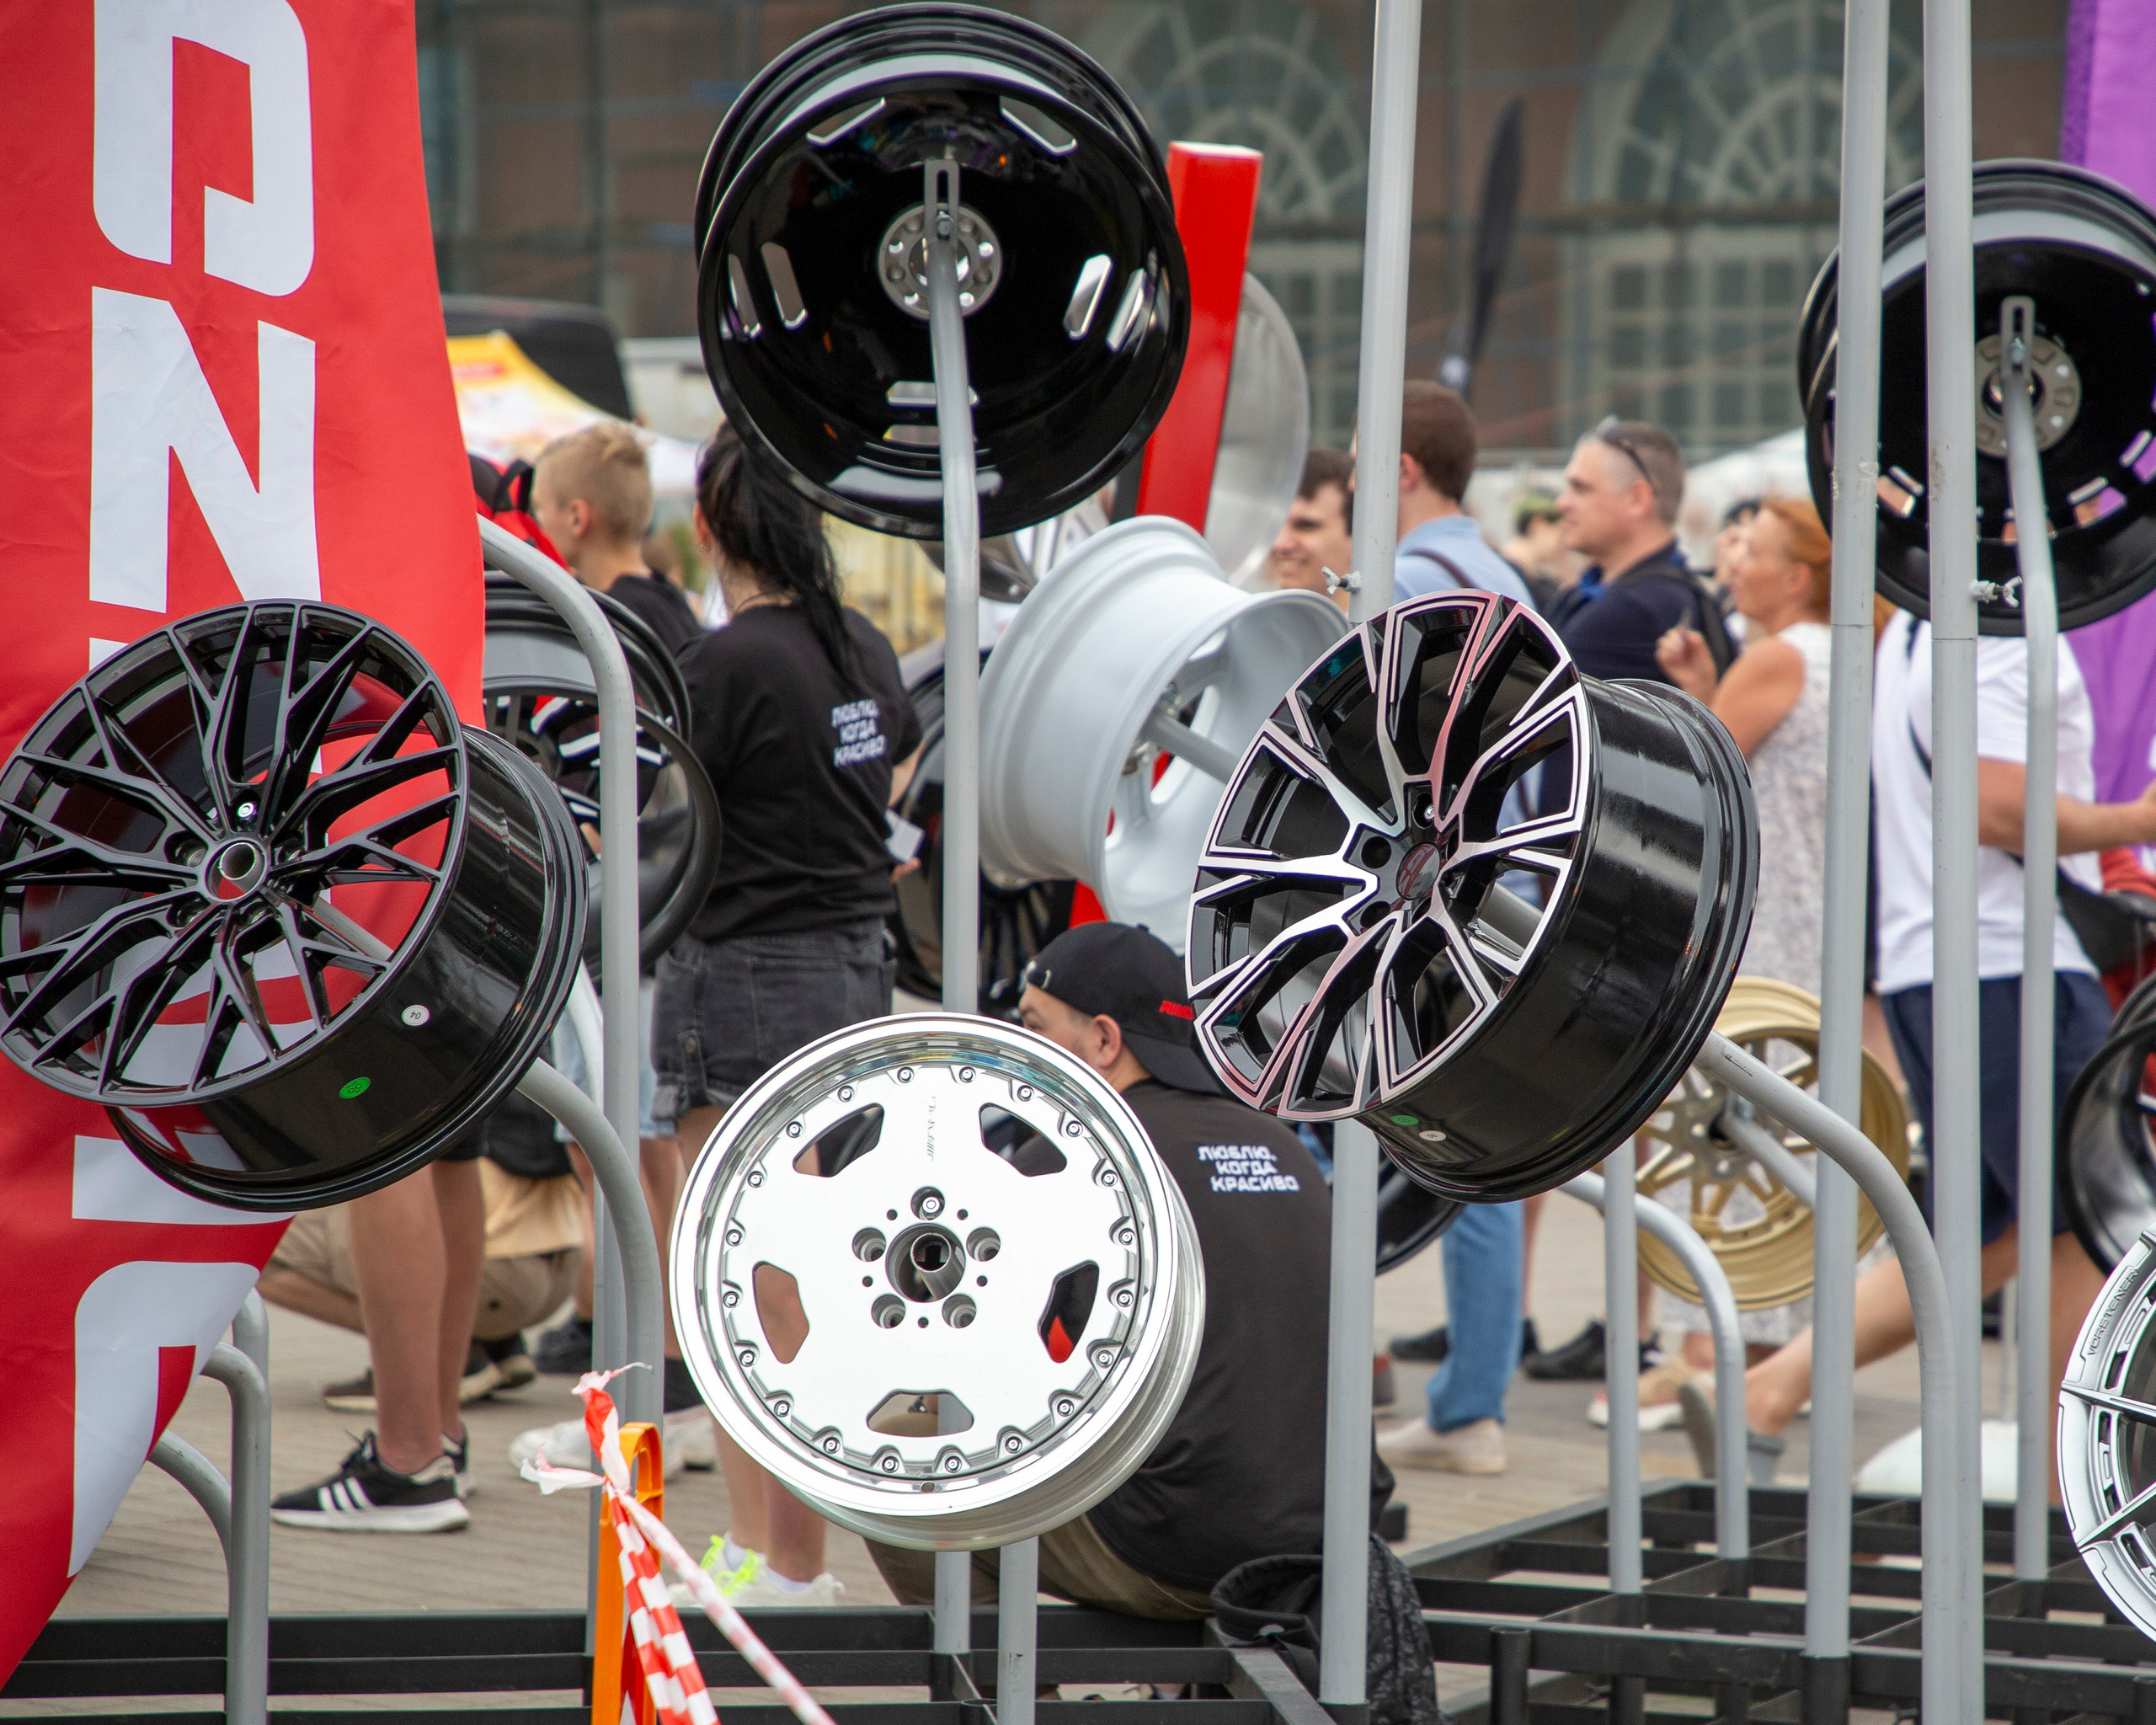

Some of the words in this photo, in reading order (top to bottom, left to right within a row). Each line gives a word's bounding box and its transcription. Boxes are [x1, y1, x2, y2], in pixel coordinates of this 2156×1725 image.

[839, 718, 877, 745] КОГДА
[833, 734, 886, 767] КРАСИВО
[1198, 1145, 1278, 1162] ЛЮБЛЮ,
[1215, 1160, 1278, 1176] КОГДА
[1210, 1174, 1300, 1193] КРАСИВО
